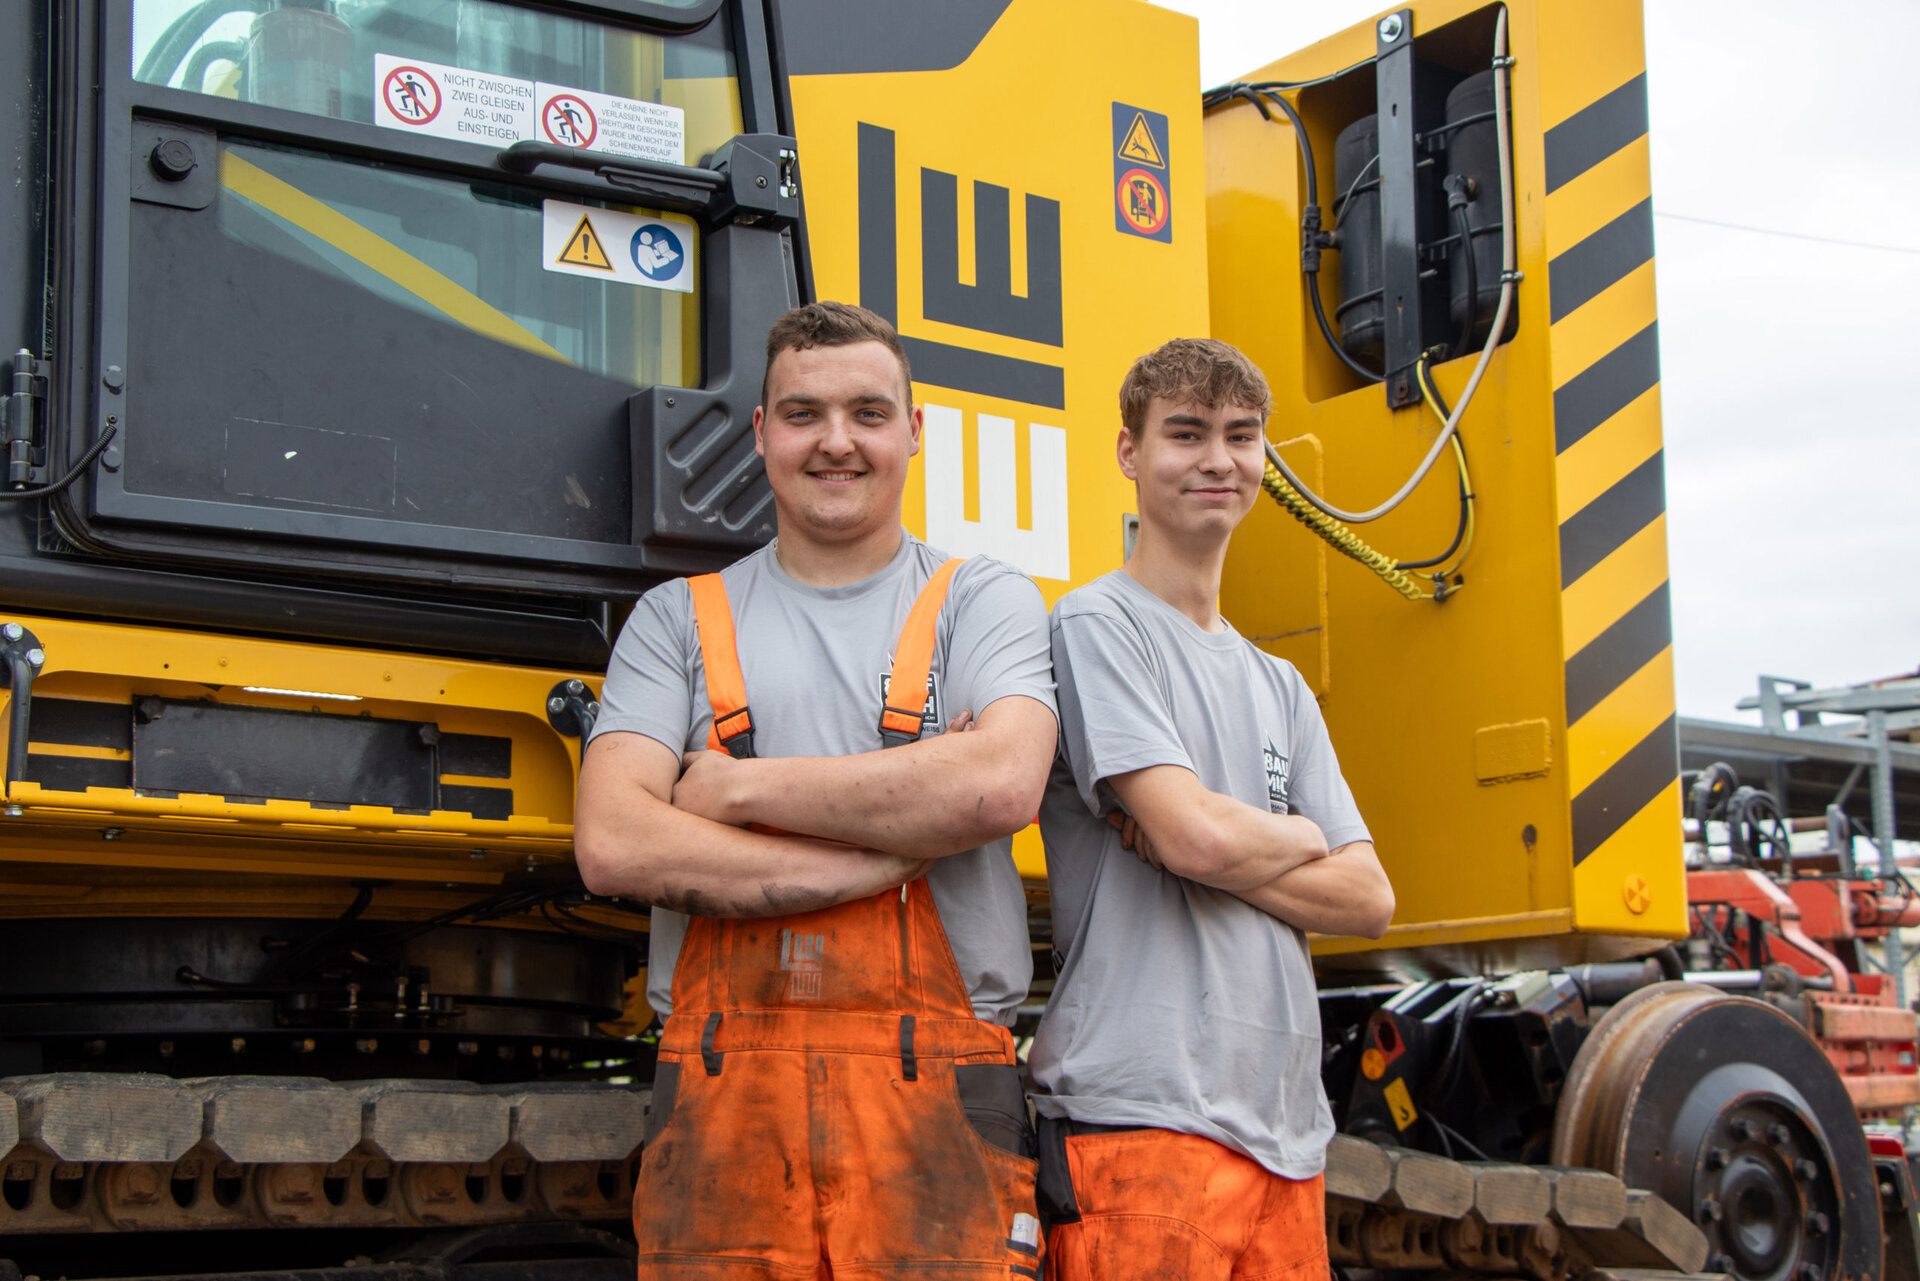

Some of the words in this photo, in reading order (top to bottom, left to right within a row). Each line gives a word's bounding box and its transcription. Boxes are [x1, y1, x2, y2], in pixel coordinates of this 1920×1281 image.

[444, 73, 475, 88] NICHT
[478, 80, 532, 98] ZWISCHEN
[452, 90, 478, 103] ZWEI
[480, 95, 525, 111] GLEISEN
[611, 101, 622, 109] DIE
[624, 104, 647, 114] KABINE
[649, 108, 669, 117] NICHT
[463, 107, 488, 120] AUS-
[491, 112, 514, 125] UND
[644, 117, 663, 126] WENN
[665, 120, 679, 129] DER
[457, 121, 520, 140] EINSTEIGEN
[598, 118, 635, 129] DREHTURM
[636, 125, 682, 139] GESCHWENKT
[601, 129, 626, 139] WURDE
[627, 133, 642, 142] UND
[643, 136, 663, 145] NICHT
[664, 140, 679, 148] DEM
[608, 139, 673, 156] SCHIENENVERLAUF
